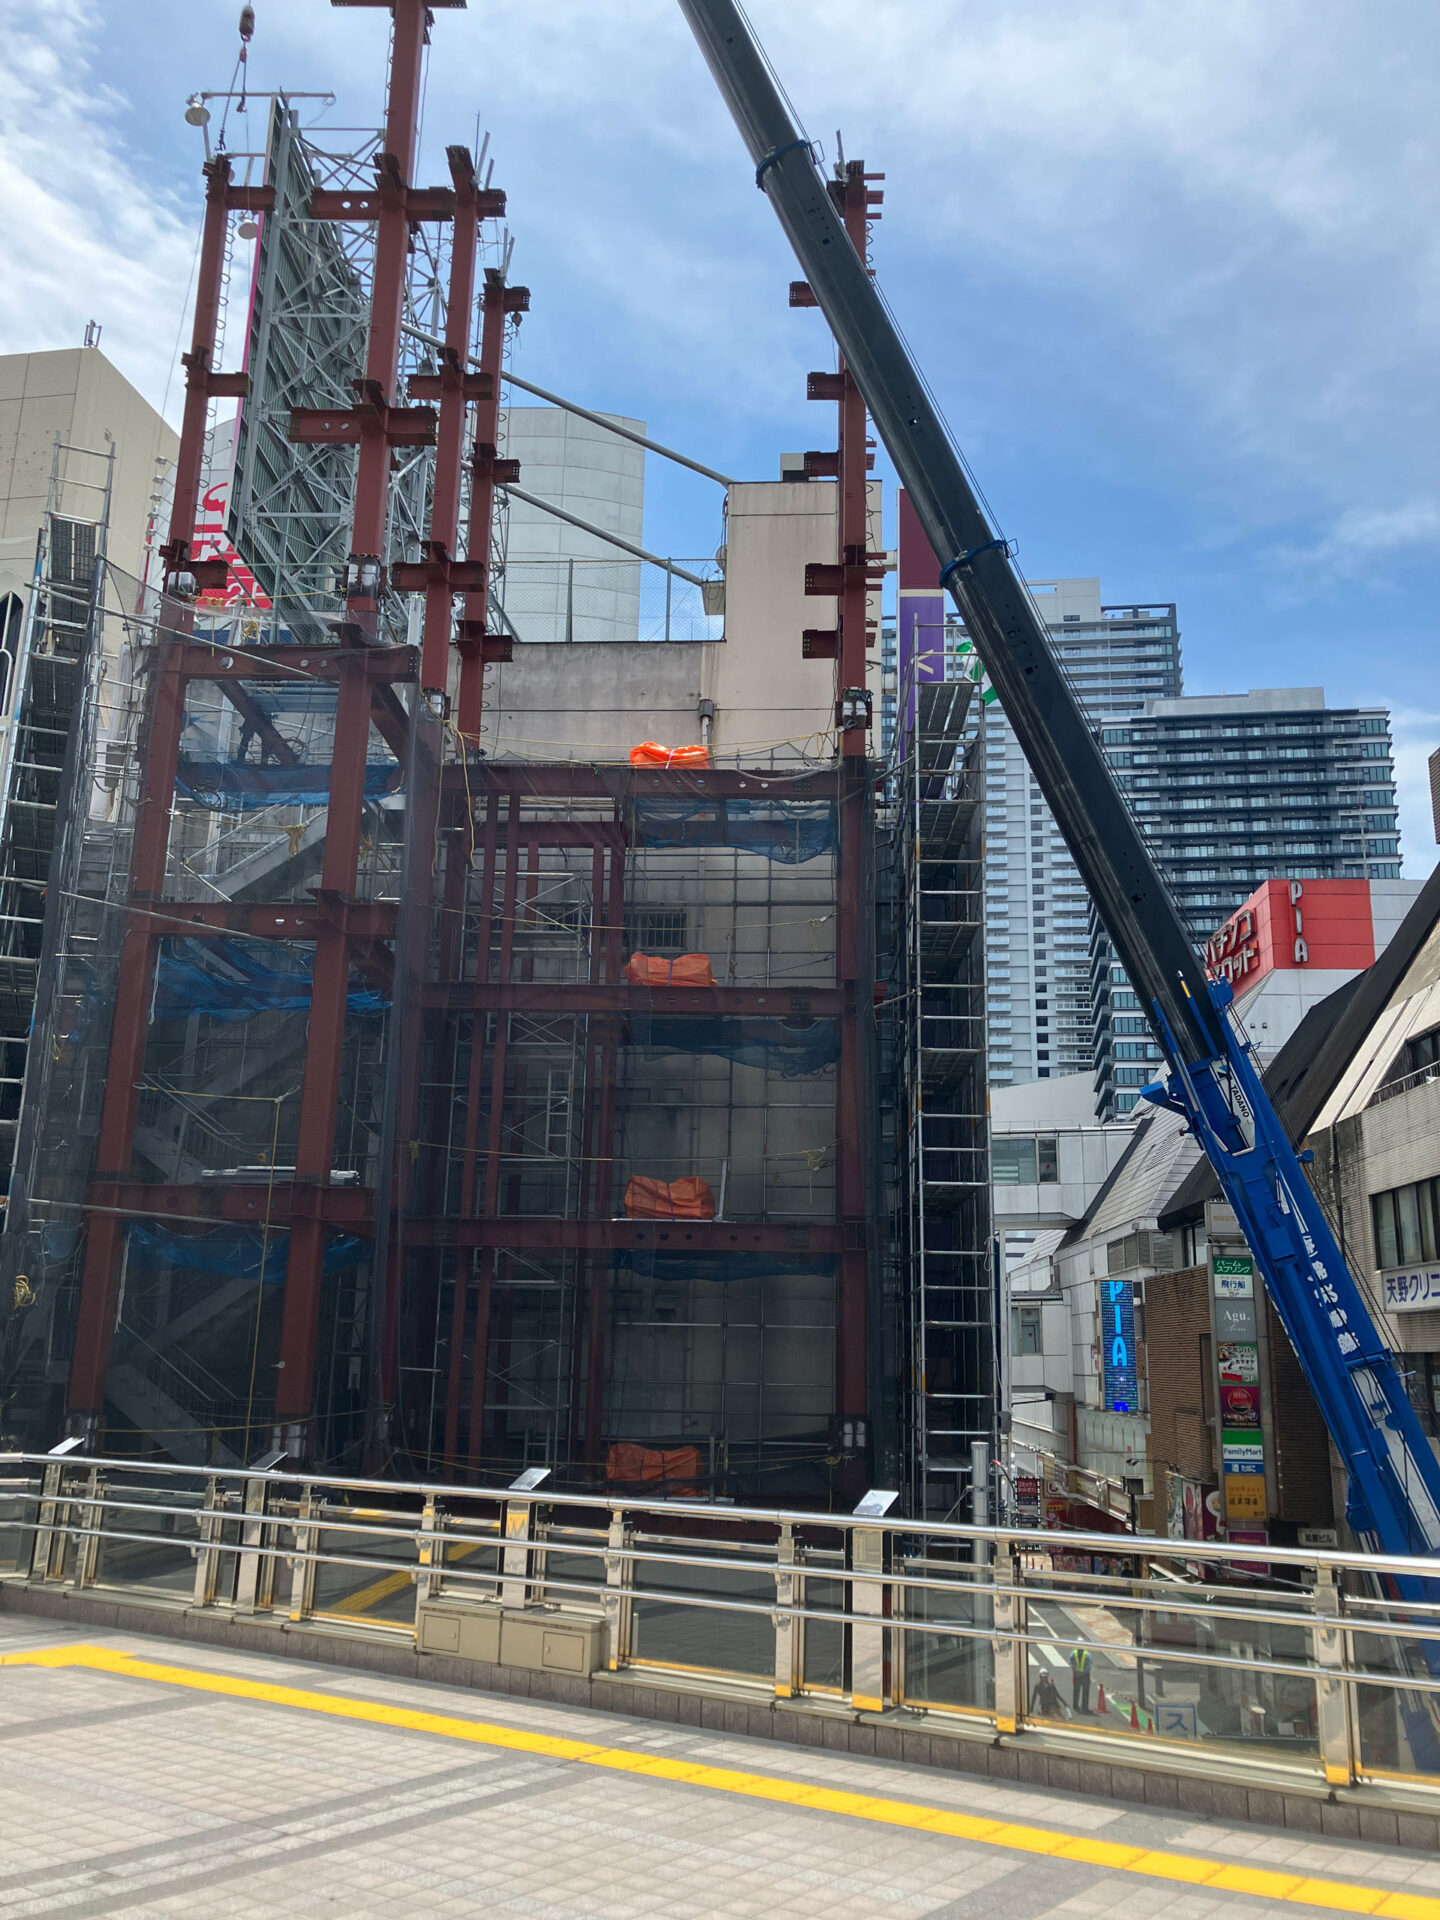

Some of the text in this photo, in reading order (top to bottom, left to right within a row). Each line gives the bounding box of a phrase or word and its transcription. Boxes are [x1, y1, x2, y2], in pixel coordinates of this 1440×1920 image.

[1290, 880, 1308, 962] PIA
[1230, 1084, 1250, 1118] TADANO
[1217, 1266, 1250, 1274] スプリング
[1221, 1280, 1246, 1289] 飛行船
[1223, 1310, 1250, 1324] Agu.
[1109, 1281, 1127, 1366] PIA
[1223, 1448, 1262, 1456] FamilyMart
[1241, 1464, 1257, 1472] たばこ
